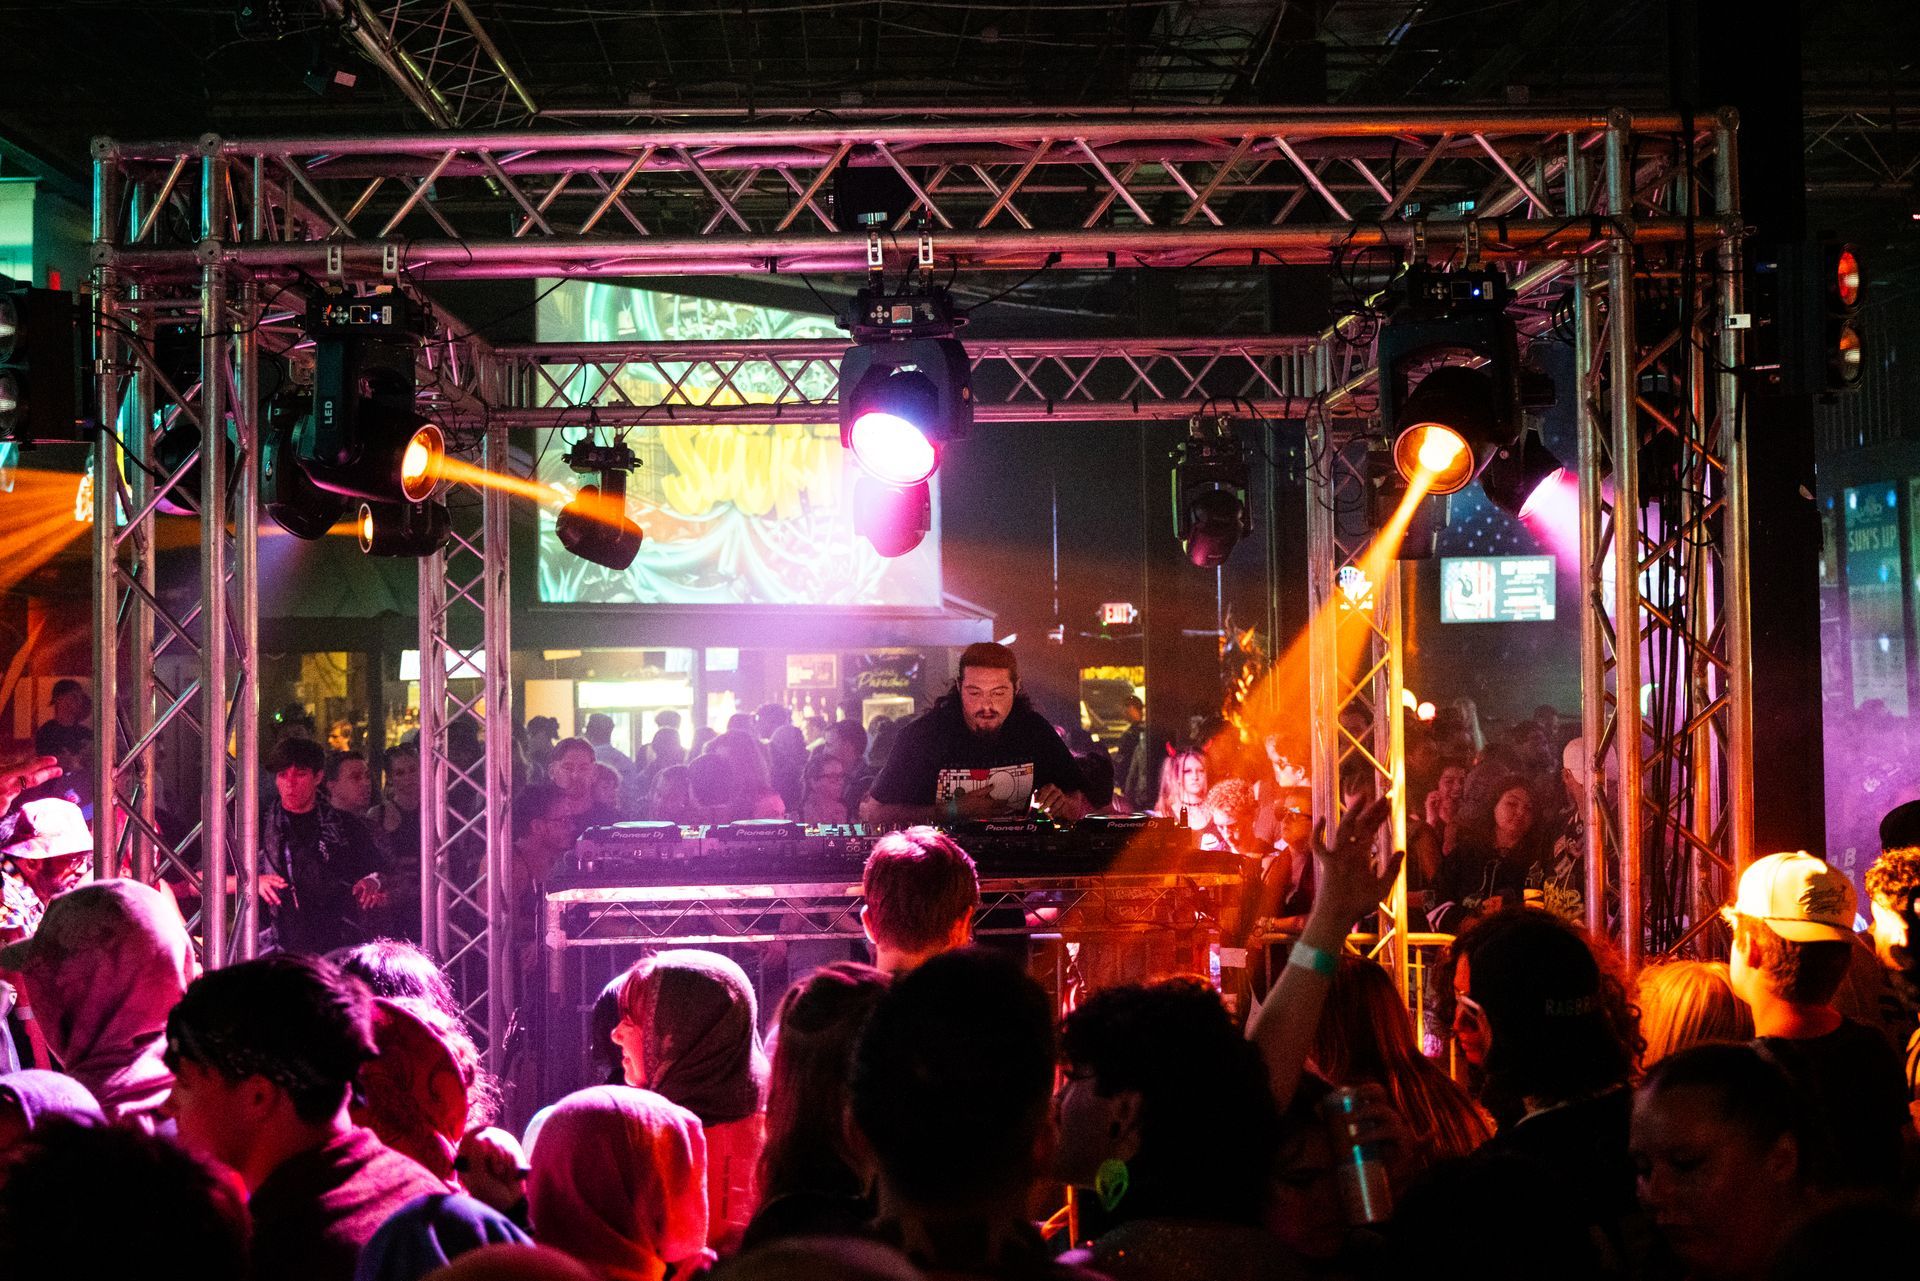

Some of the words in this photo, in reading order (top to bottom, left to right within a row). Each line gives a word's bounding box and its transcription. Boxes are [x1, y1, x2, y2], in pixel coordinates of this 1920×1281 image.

[324, 400, 333, 424] LED
[1848, 528, 1880, 552] SUN'S
[1881, 525, 1897, 547] UP
[1104, 603, 1128, 622] EXIT
[611, 831, 652, 839] Pioneer
[736, 829, 776, 837] Pioneer
